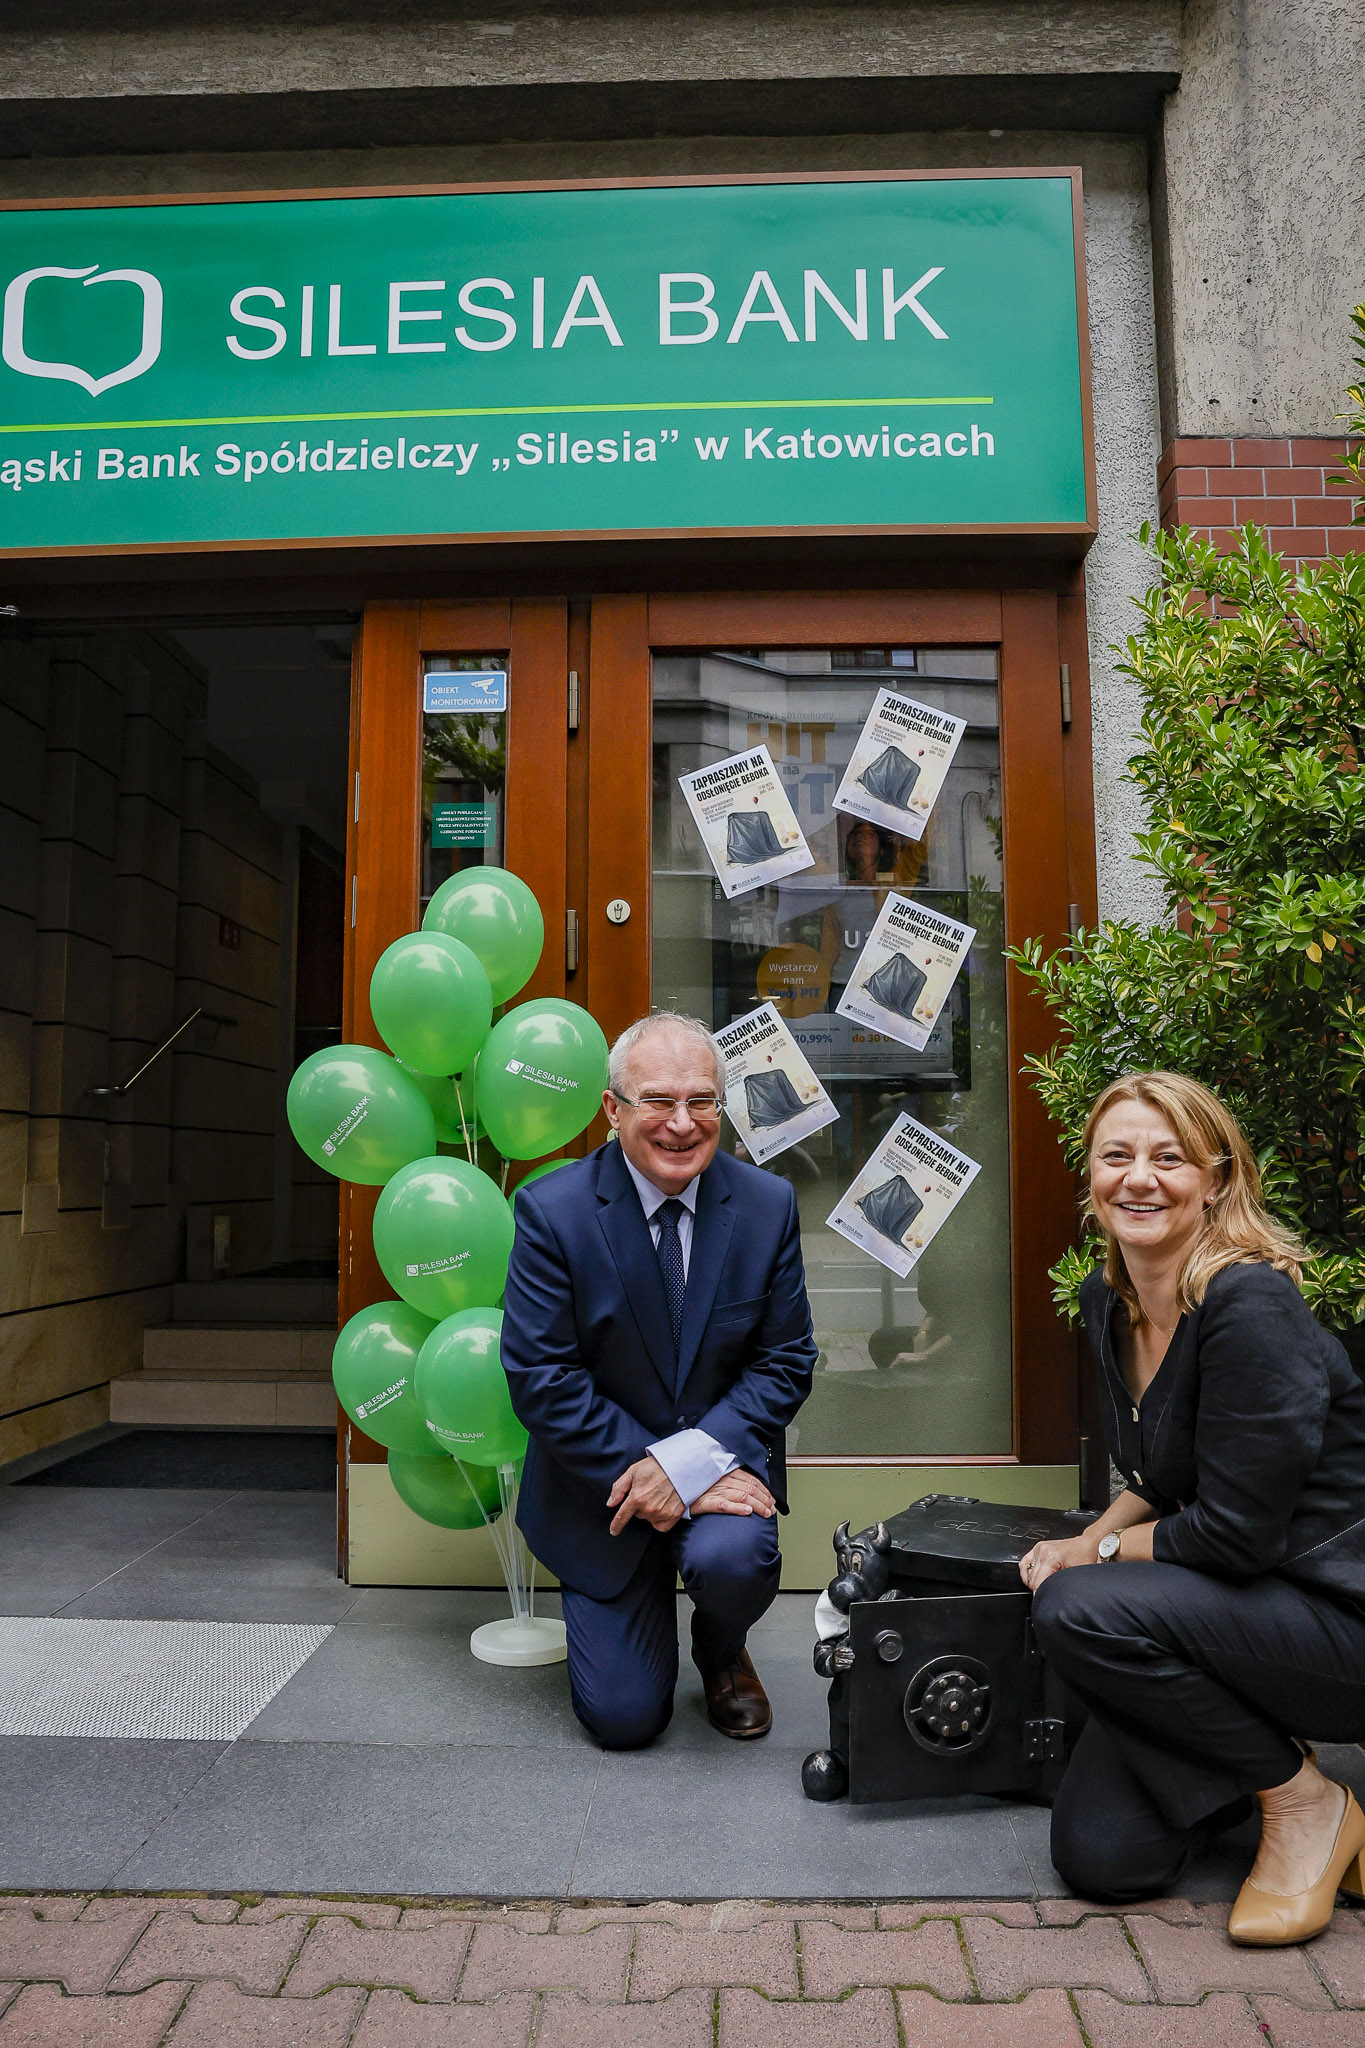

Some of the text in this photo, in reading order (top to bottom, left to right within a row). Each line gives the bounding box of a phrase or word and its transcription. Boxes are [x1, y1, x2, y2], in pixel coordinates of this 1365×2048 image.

[226, 267, 949, 360] SILESIA BANK
[98, 446, 200, 479] Bank
[215, 438, 479, 482] Spółdzielczy
[694, 437, 729, 460] w
[745, 424, 994, 459] Katowicach
[430, 698, 499, 706] MONITOROWANY
[431, 686, 460, 694] OBIEKT
[879, 709, 924, 733] ODSŁONIĘCIE
[924, 727, 951, 744] BEBOKA
[883, 697, 956, 733] ZAPRASZAMY NA
[691, 760, 749, 791] ZAPRASZAMY
[750, 755, 764, 767] NA
[696, 778, 741, 801] ODSŁONIĘCIE
[741, 767, 769, 784] BEBOKA
[888, 915, 932, 941] ODSŁONIĘCIE
[932, 934, 959, 953] BEBOKA
[892, 902, 964, 942] ZAPRASZAMY NA
[769, 963, 818, 973] Wystarczy
[801, 988, 820, 998] PIT
[716, 1019, 757, 1049] RASZAMY
[757, 1011, 772, 1026] NA
[725, 1039, 752, 1061] ONIĘCIE
[750, 1023, 779, 1044] BEBOKA
[852, 1033, 865, 1043] do
[868, 1034, 881, 1043] 30
[524, 1065, 579, 1088] SILESIA BANK
[330, 1096, 371, 1142] SILESIA BANK
[894, 1135, 937, 1168] ODSŁONIĘCIE
[935, 1163, 962, 1186] BEBOKA
[901, 1123, 958, 1166] ZAPRASZAMY
[955, 1160, 970, 1176] NA
[419, 1250, 471, 1270] SILESIA BANK
[364, 1376, 408, 1409] SILESIA BANK
